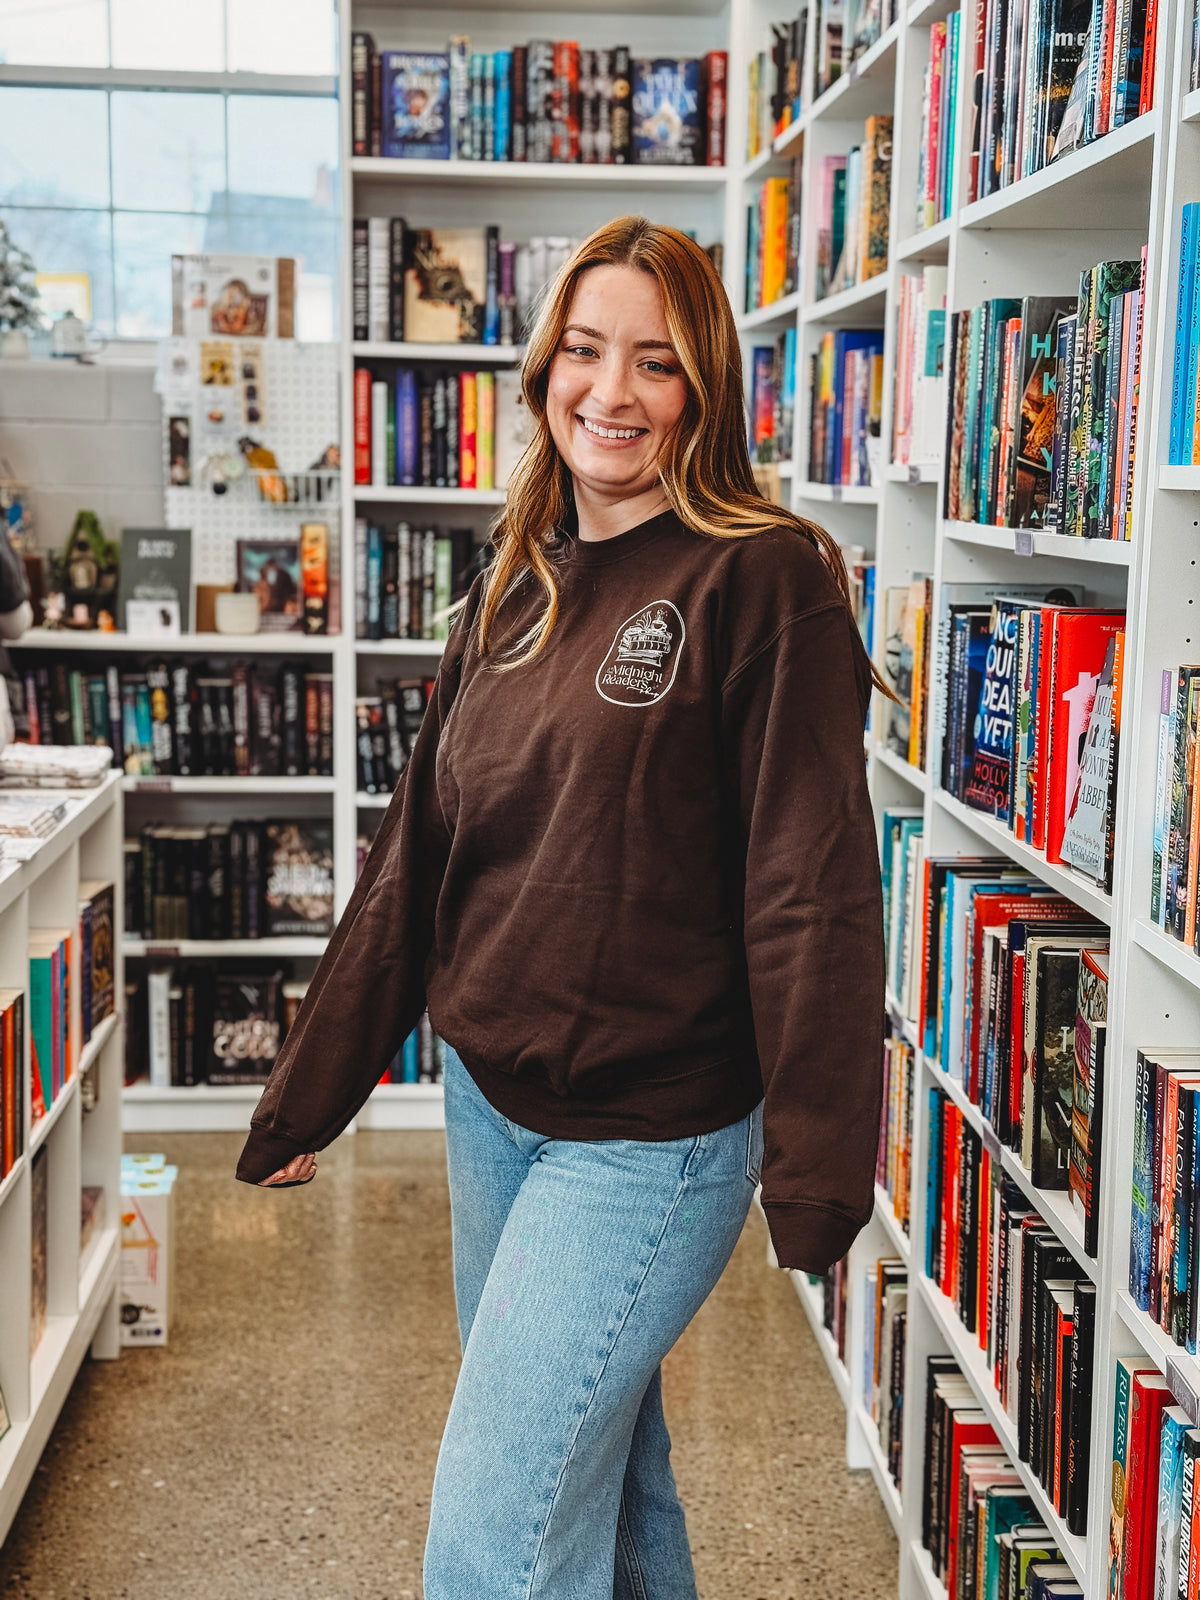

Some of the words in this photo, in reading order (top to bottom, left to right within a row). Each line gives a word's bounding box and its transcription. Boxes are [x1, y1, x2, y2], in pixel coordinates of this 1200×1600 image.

[1066, 326, 1075, 361] PAULA
[1093, 318, 1103, 355] SALLY
[1189, 341, 1197, 372] JOAN
[1061, 365, 1071, 421] HAWKINS
[1172, 374, 1180, 420] EMBOLA
[1186, 375, 1194, 420] EMBOLA
[1079, 411, 1088, 454] RACHEL
[1129, 405, 1138, 455] FEVER
[1059, 454, 1067, 480] BLUE
[1069, 446, 1079, 487] RACHEL
[1126, 460, 1135, 513] BEACH
[1056, 481, 1065, 507] HOUR
[601, 673, 649, 691] Readers
[612, 664, 663, 684] Midnight
[1111, 643, 1121, 693] WILLIAM
[982, 678, 1014, 716] DEA
[1109, 699, 1118, 729] KENT
[982, 713, 1013, 751] YET
[1031, 701, 1041, 774] HAPPINESS
[974, 762, 1009, 788] HOLLY
[1104, 733, 1115, 786] KRUEGER
[1029, 780, 1038, 820] FALLS
[1103, 798, 1113, 821] FOX
[1089, 1042, 1097, 1108] DROWNING
[1135, 1061, 1143, 1113] COLD
[1142, 1070, 1150, 1121] COLD
[1175, 1107, 1186, 1198] FALLOUT
[1116, 1375, 1128, 1460] RIVERS
[1068, 1437, 1076, 1484] KARIN
[1160, 1426, 1174, 1516] RIVERS
[1182, 1453, 1194, 1514] SILENT
[1178, 1515, 1192, 1598] HORIZONS
